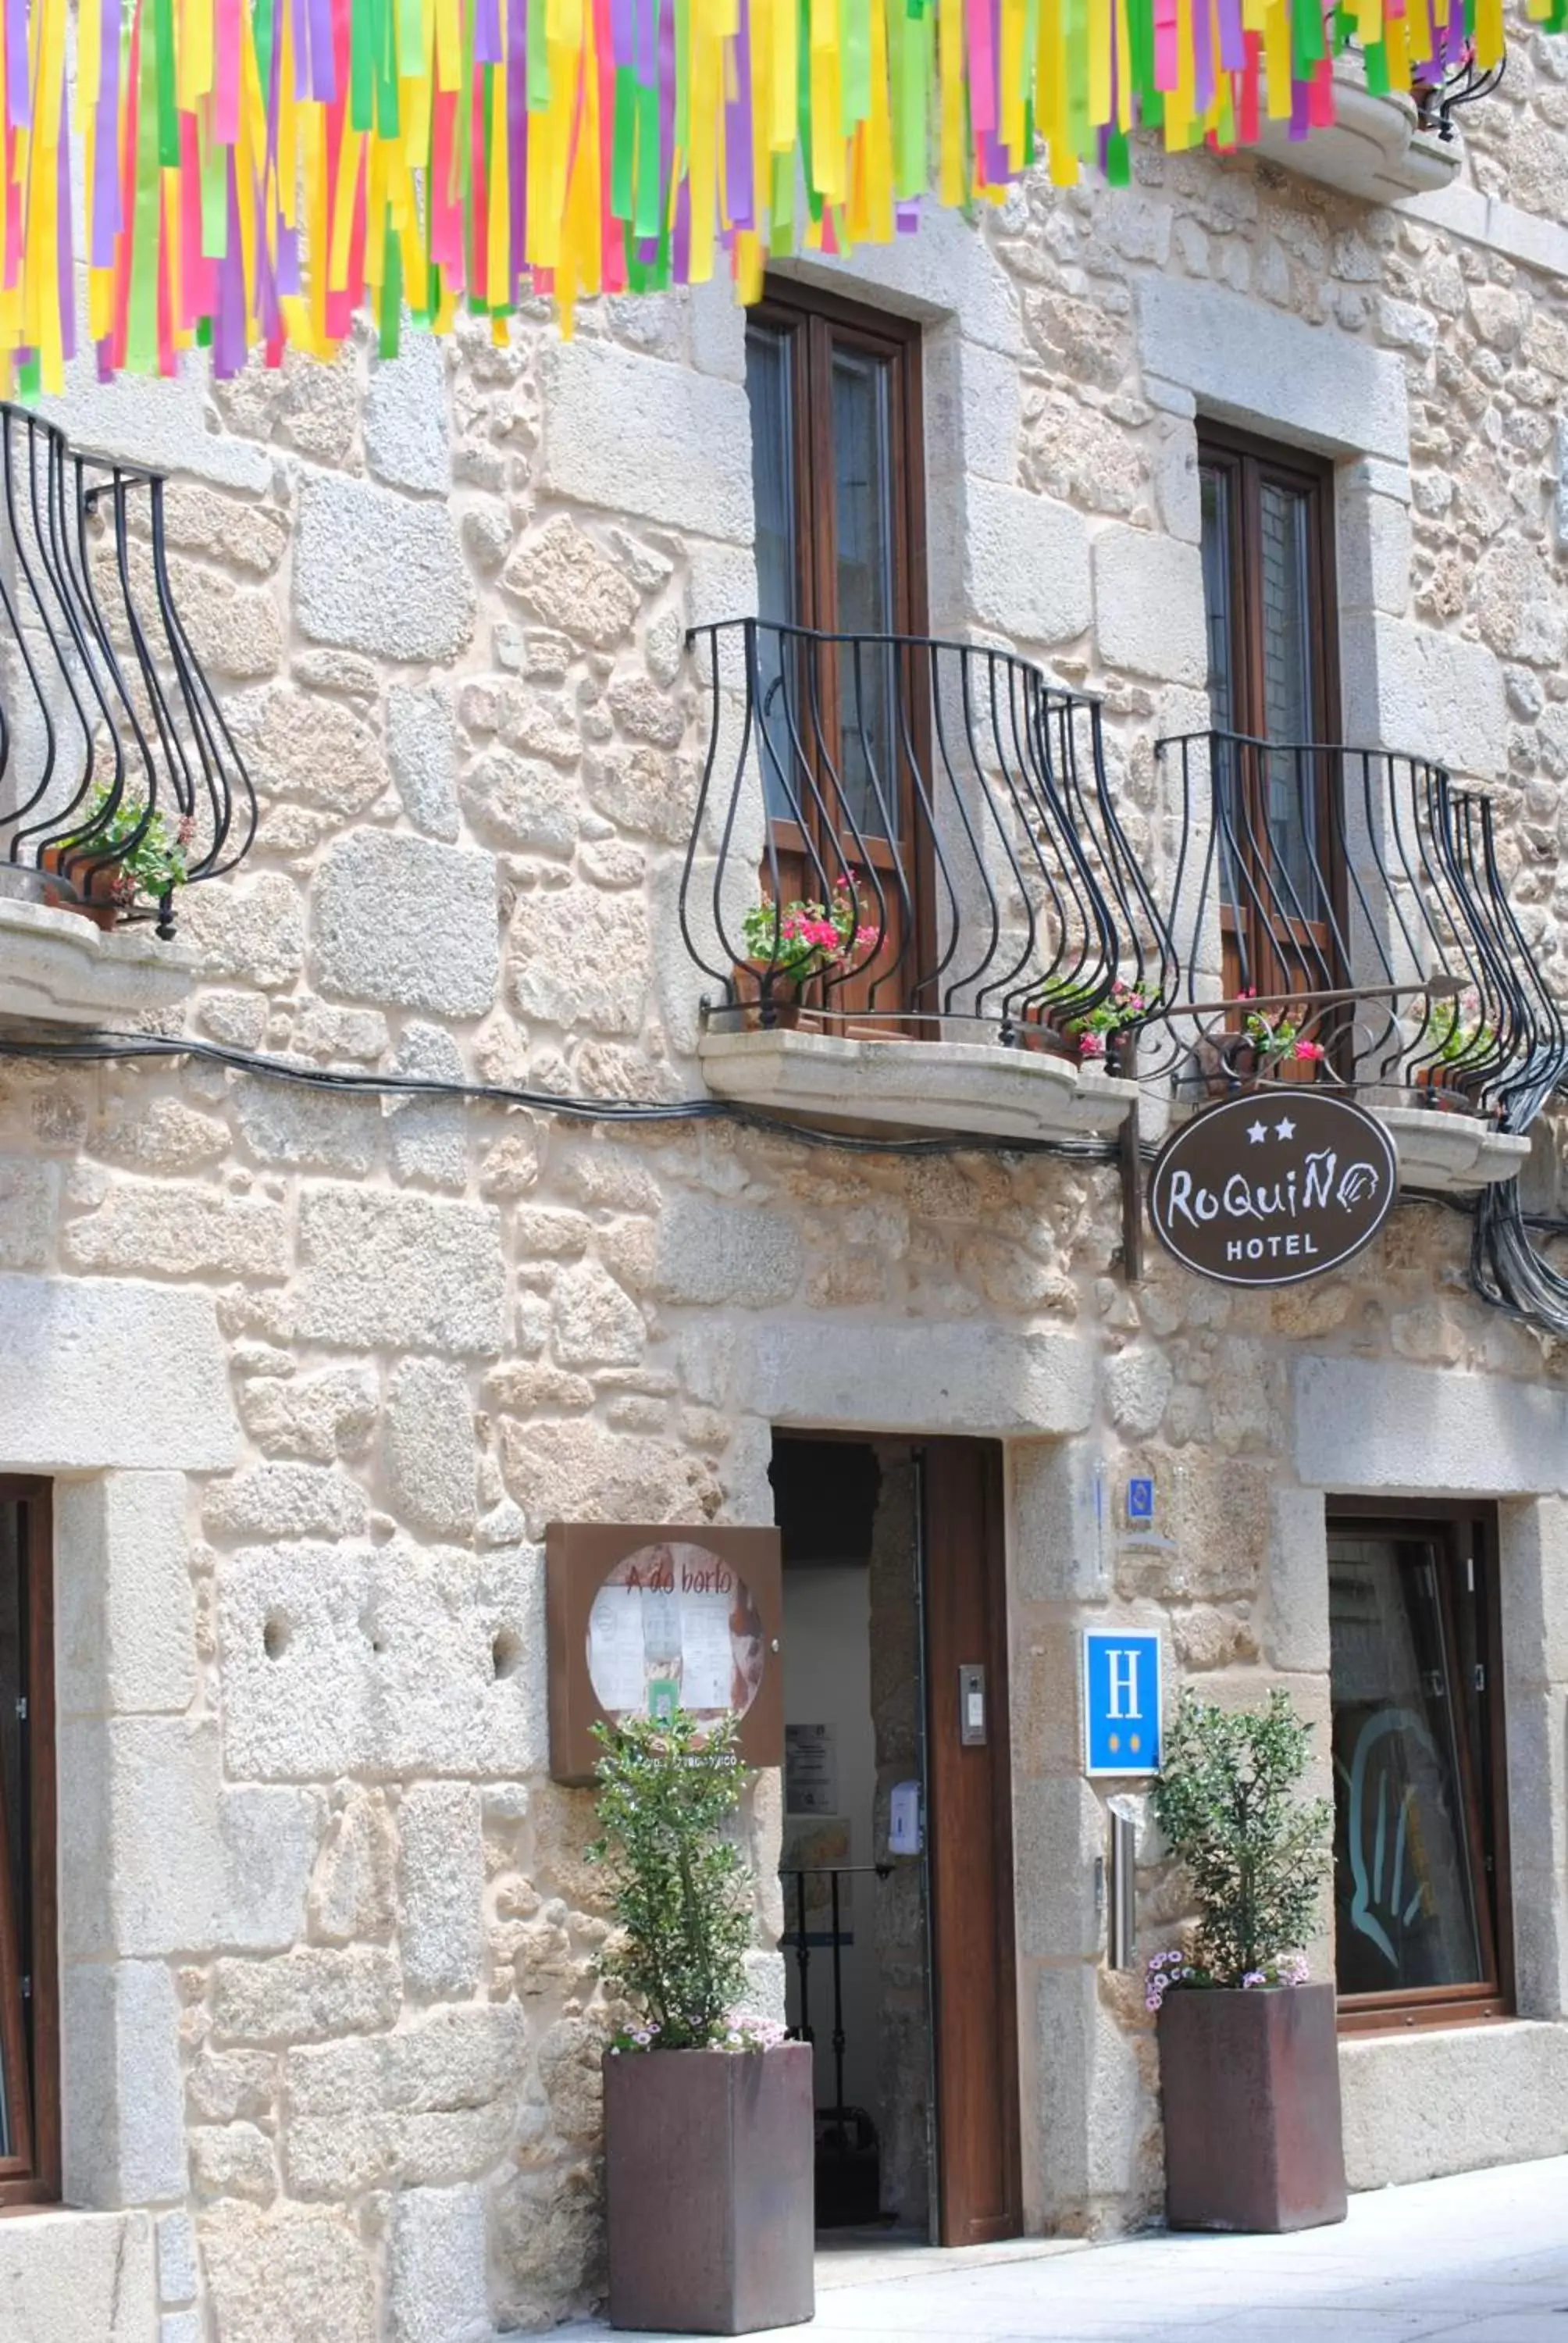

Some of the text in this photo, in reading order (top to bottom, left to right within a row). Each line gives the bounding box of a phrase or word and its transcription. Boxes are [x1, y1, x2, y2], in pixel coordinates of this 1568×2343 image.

[1226, 1233, 1319, 1261] HOTEL
[626, 1564, 643, 1596] A
[647, 1558, 675, 1595] do
[1104, 1649, 1143, 1719] H
